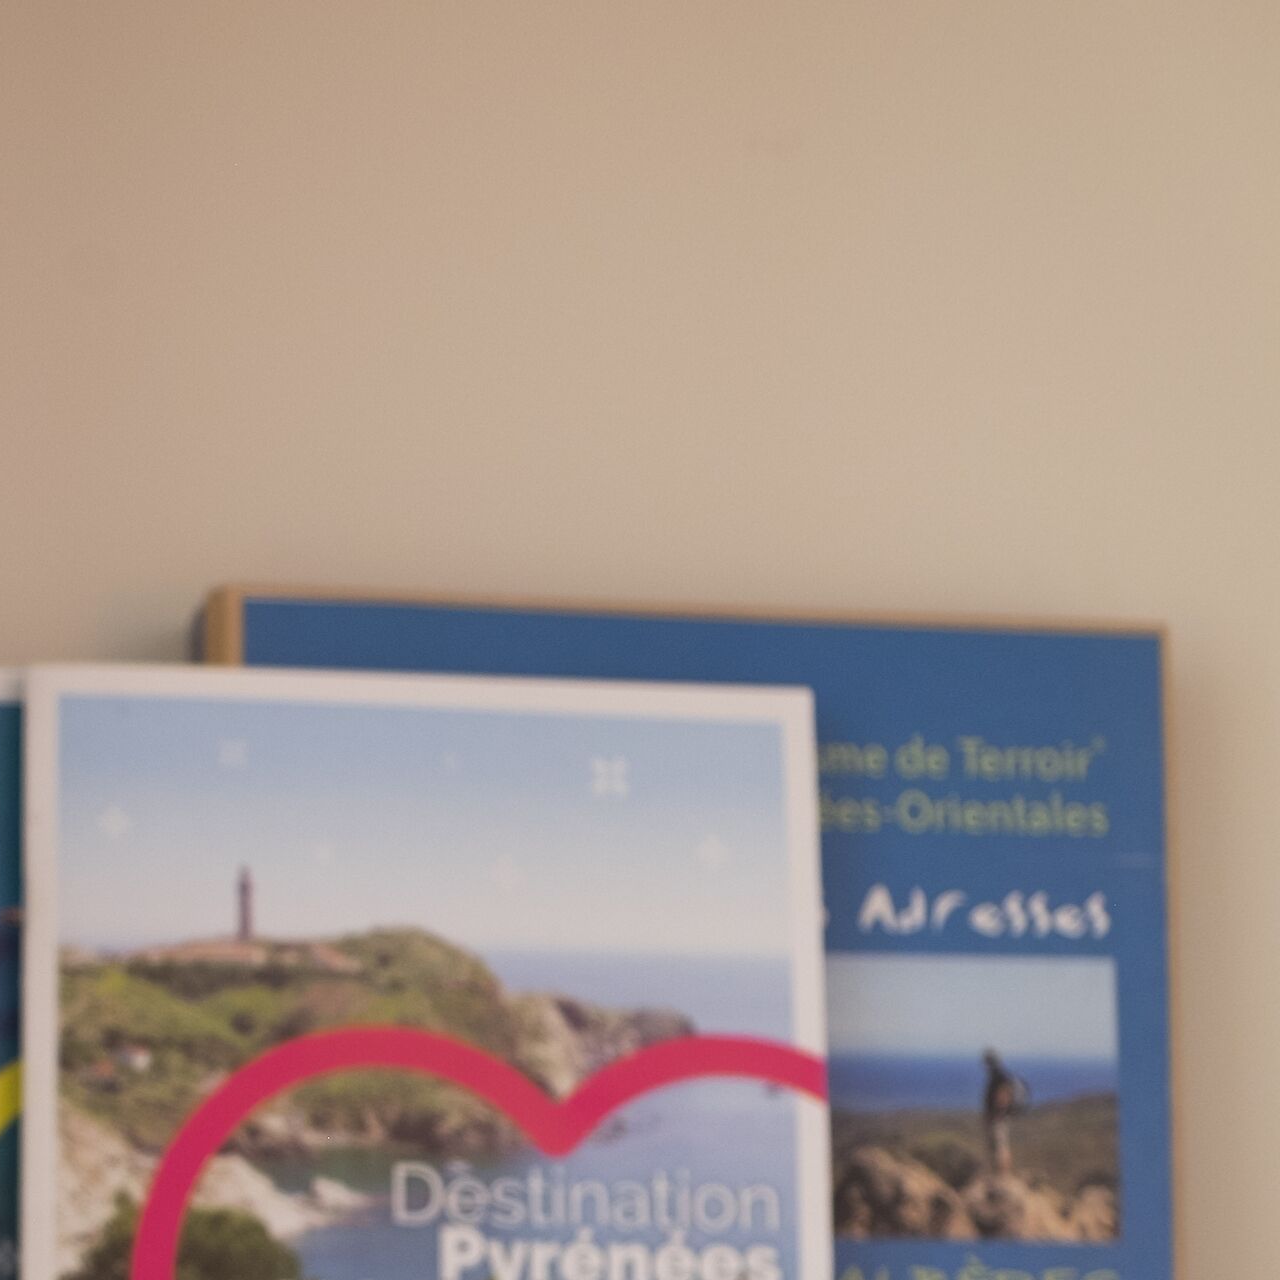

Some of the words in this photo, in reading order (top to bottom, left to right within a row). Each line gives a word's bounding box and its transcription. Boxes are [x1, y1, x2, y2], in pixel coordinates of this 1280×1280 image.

[896, 734, 950, 780] de
[858, 883, 1111, 938] Adresses
[391, 1160, 781, 1234] Destination
